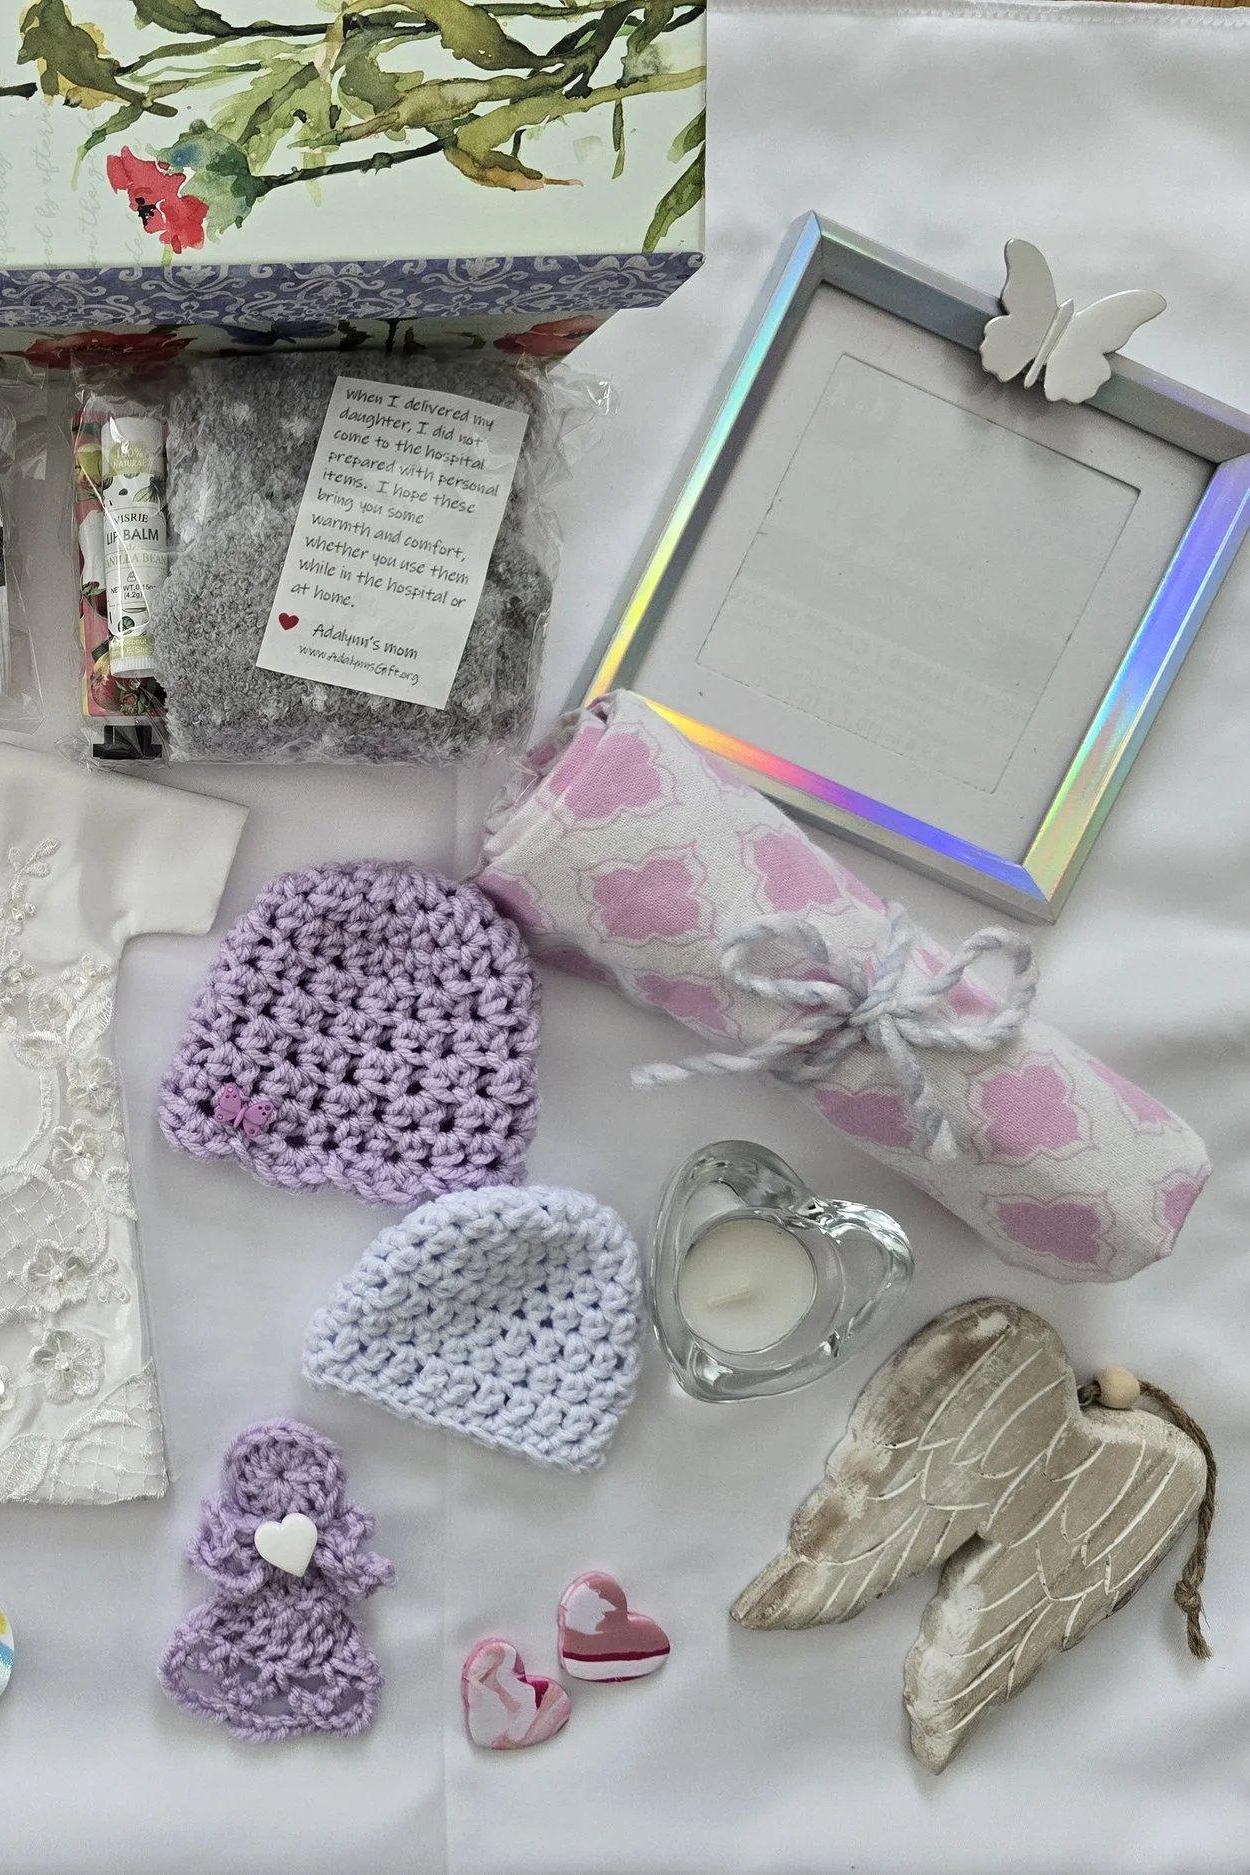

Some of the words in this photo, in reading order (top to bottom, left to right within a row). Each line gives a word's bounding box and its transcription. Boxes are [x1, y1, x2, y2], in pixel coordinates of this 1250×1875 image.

[338, 406, 411, 433] daughter,
[416, 421, 429, 435] I
[431, 424, 455, 440] did
[458, 434, 480, 447] not
[386, 394, 400, 408] I
[403, 397, 470, 422] delivered
[473, 414, 494, 432] my
[333, 429, 370, 445] come
[374, 435, 390, 449] to
[394, 439, 422, 455] the
[424, 444, 485, 470] hospital
[123, 528, 159, 541] BALM
[311, 513, 370, 537] warmth
[373, 529, 402, 543] and
[403, 536, 465, 562] comfort,
[383, 642, 418, 660] mom
